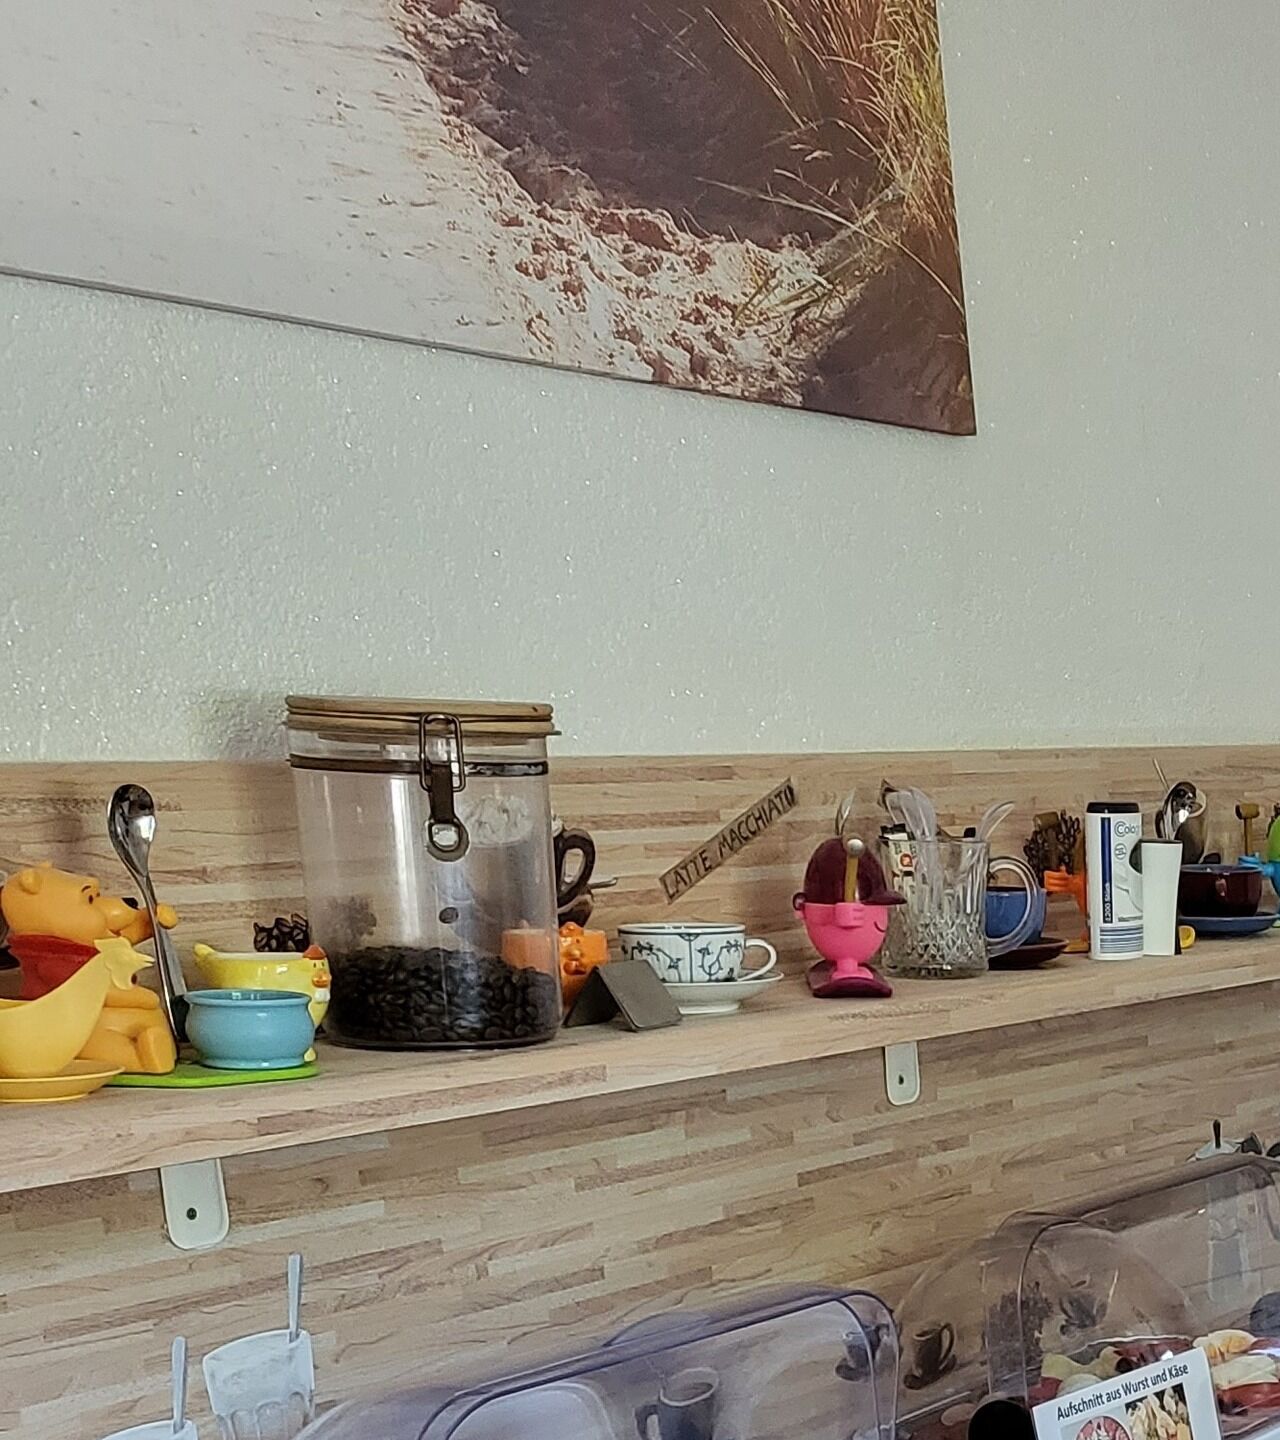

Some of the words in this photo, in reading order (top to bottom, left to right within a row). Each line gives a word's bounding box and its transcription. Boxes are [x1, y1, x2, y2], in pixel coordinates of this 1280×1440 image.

[662, 849, 713, 900] LATTE
[1057, 1392, 1105, 1421] Aufschnitt
[1105, 1387, 1122, 1400] aus
[1120, 1375, 1151, 1396] Wurst
[1150, 1368, 1168, 1385] und
[1168, 1362, 1189, 1381] Käse
